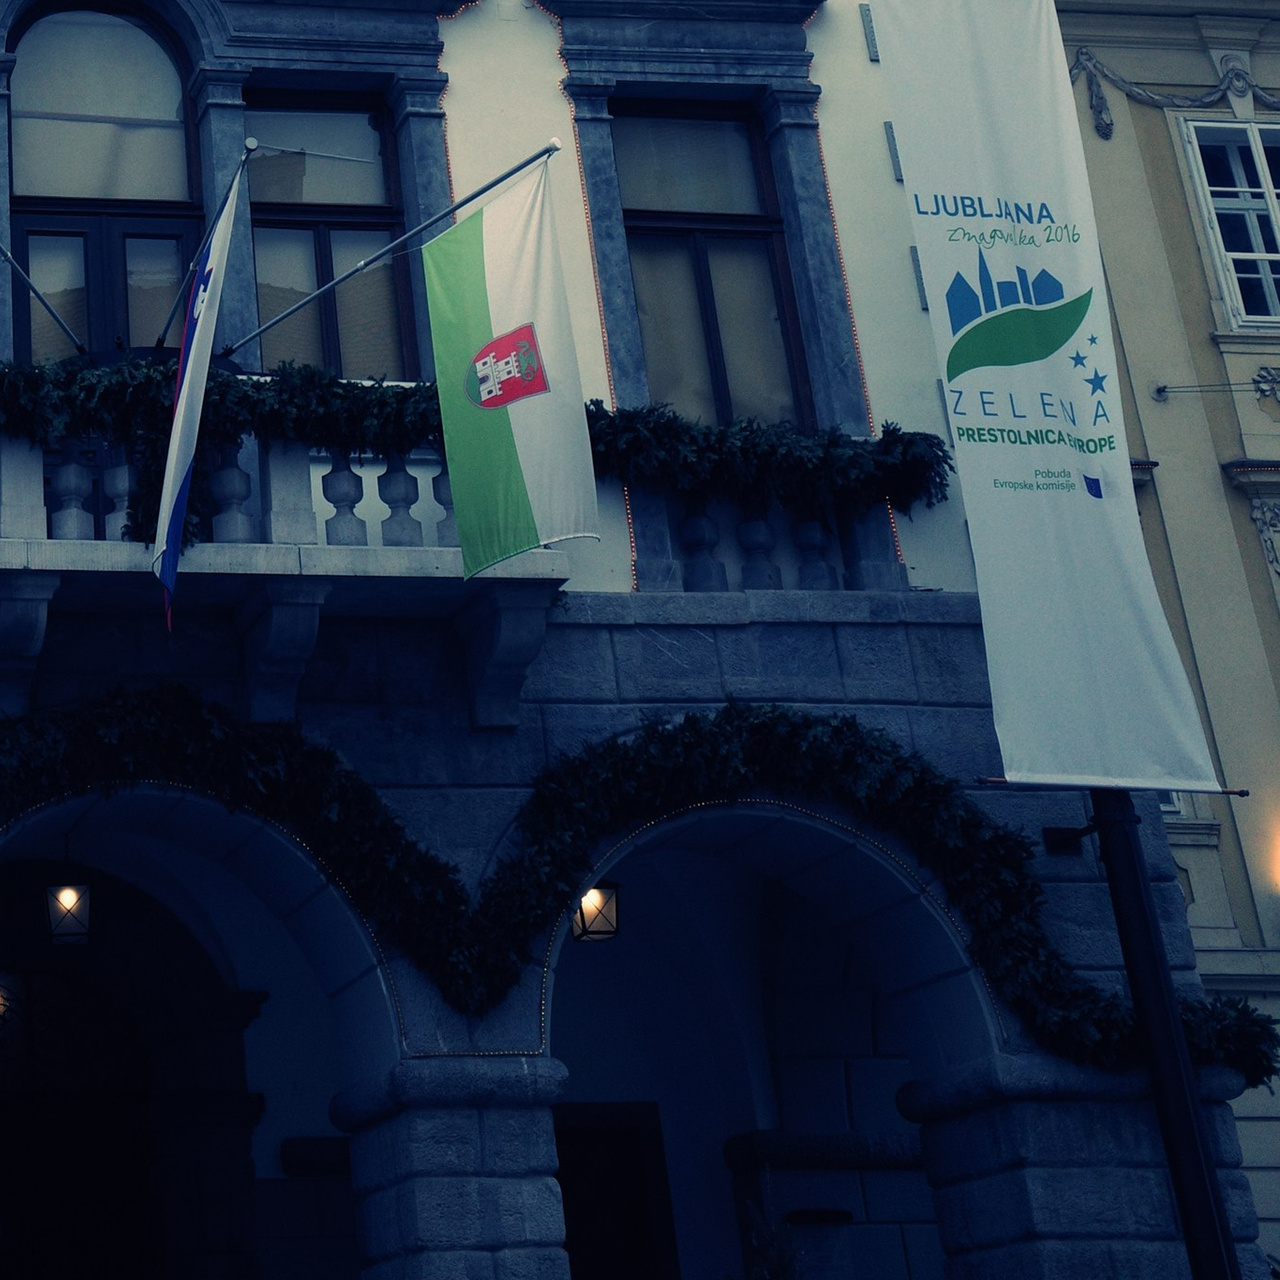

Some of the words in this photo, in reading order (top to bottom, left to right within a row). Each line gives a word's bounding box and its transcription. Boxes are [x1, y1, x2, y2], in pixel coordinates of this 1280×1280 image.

[914, 193, 1056, 224] LJUBLJANA
[1043, 224, 1081, 243] 2016
[950, 389, 1110, 426] ZELENA
[956, 426, 1067, 445] PRESTOLNICA
[1066, 432, 1116, 454] EVROPE
[993, 479, 1034, 491] Evropske
[1036, 480, 1076, 492] komisije
[1034, 469, 1071, 479] Pobuda
